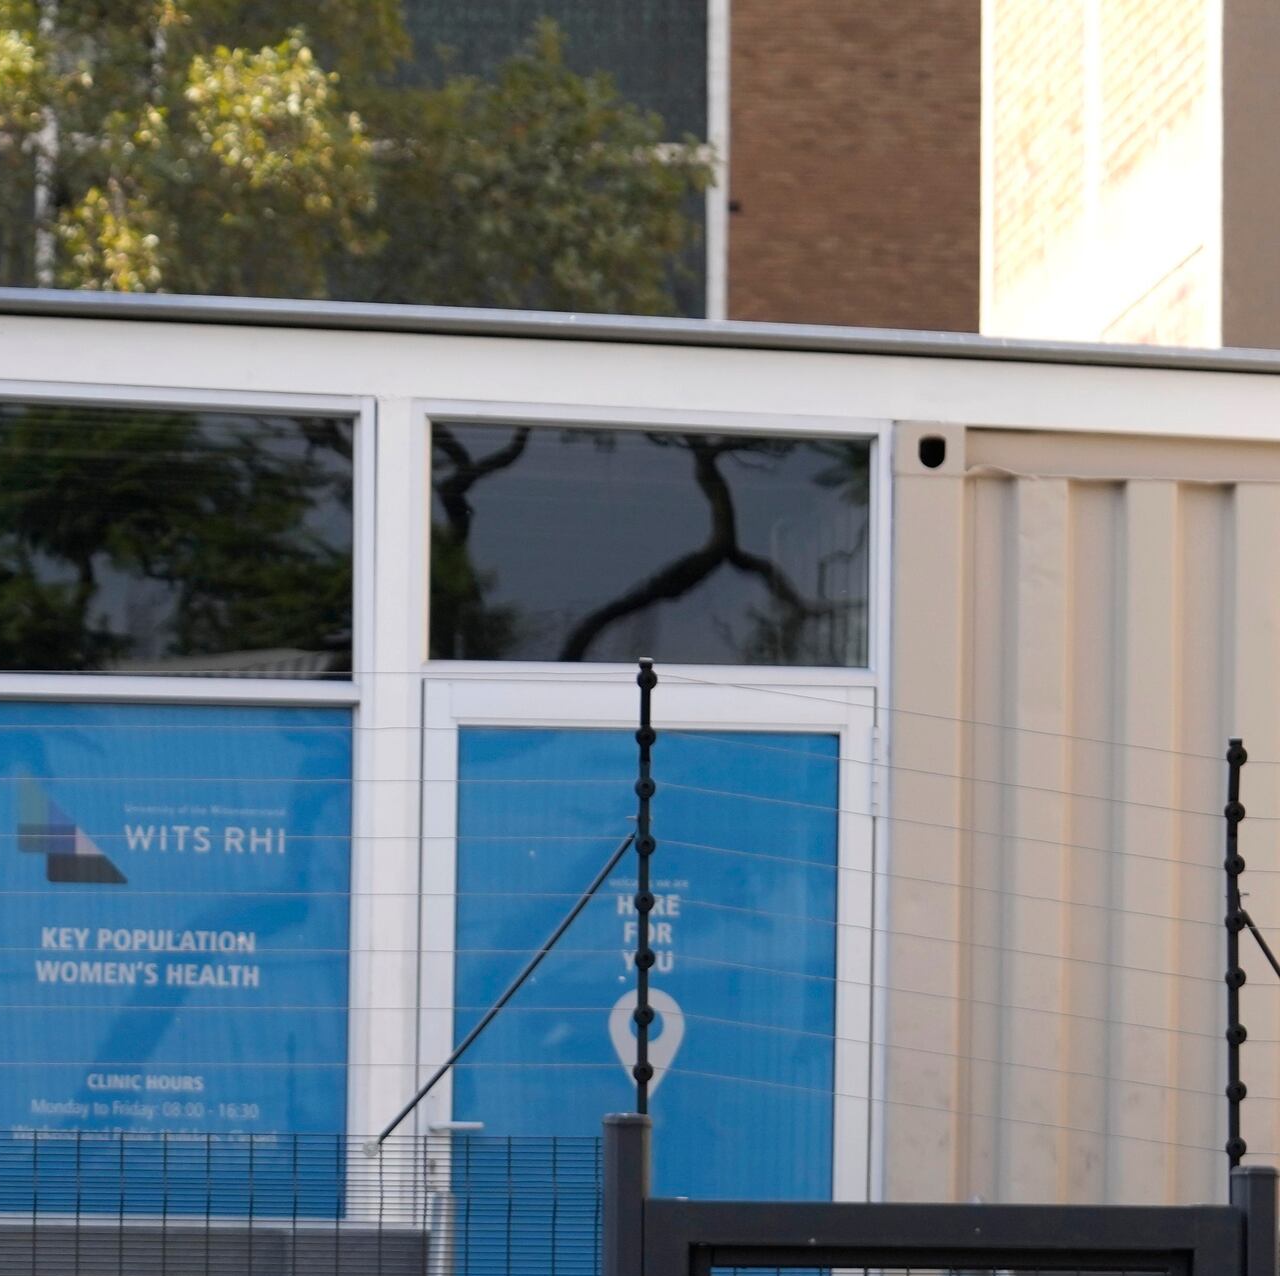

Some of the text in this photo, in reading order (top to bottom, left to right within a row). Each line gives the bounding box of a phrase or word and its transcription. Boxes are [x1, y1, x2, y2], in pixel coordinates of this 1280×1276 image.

[124, 824, 286, 854] WITS RHI
[617, 894, 680, 917] HRE
[41, 927, 256, 953] KEY POPULATION
[623, 950, 673, 973] YU
[34, 960, 260, 987] WOMEN'S HEALTH
[87, 1073, 205, 1092] CLINIC HOURS
[31, 1099, 89, 1119] Monday
